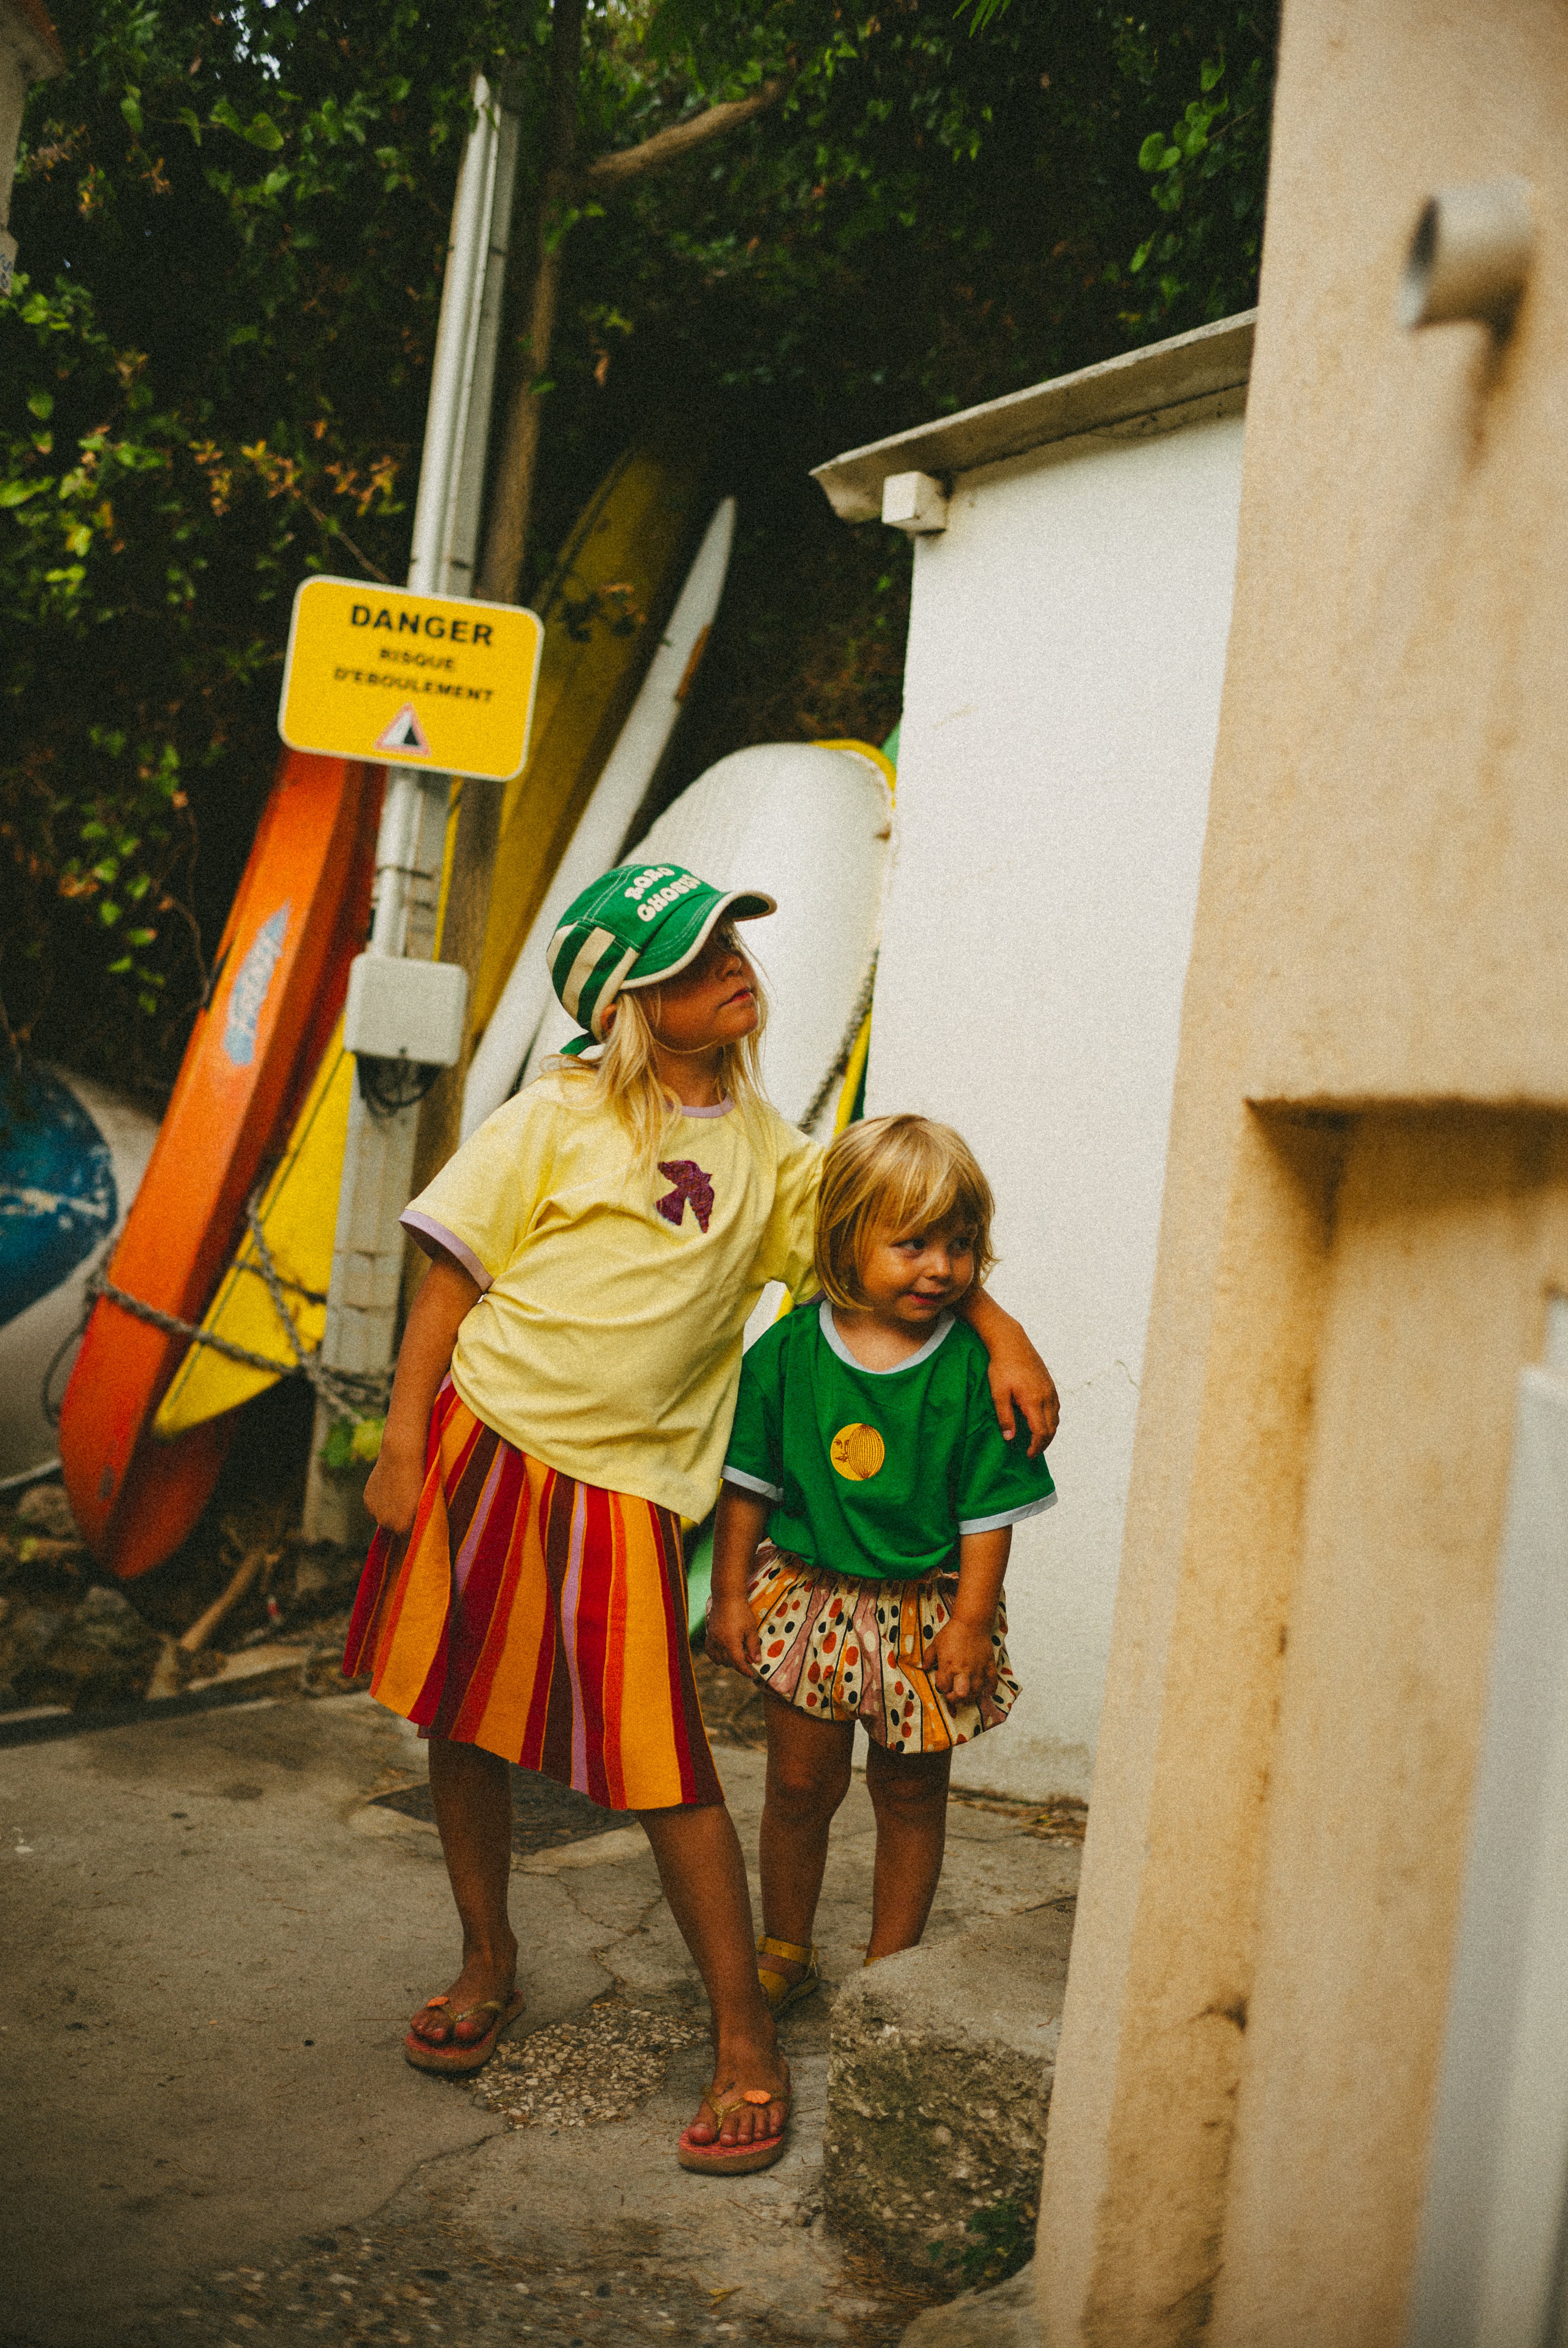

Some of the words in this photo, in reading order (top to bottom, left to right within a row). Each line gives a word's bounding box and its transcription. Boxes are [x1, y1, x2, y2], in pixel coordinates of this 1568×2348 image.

[351, 604, 493, 646] DANGER
[380, 648, 454, 671] RISQUE
[624, 867, 675, 900] BOBO
